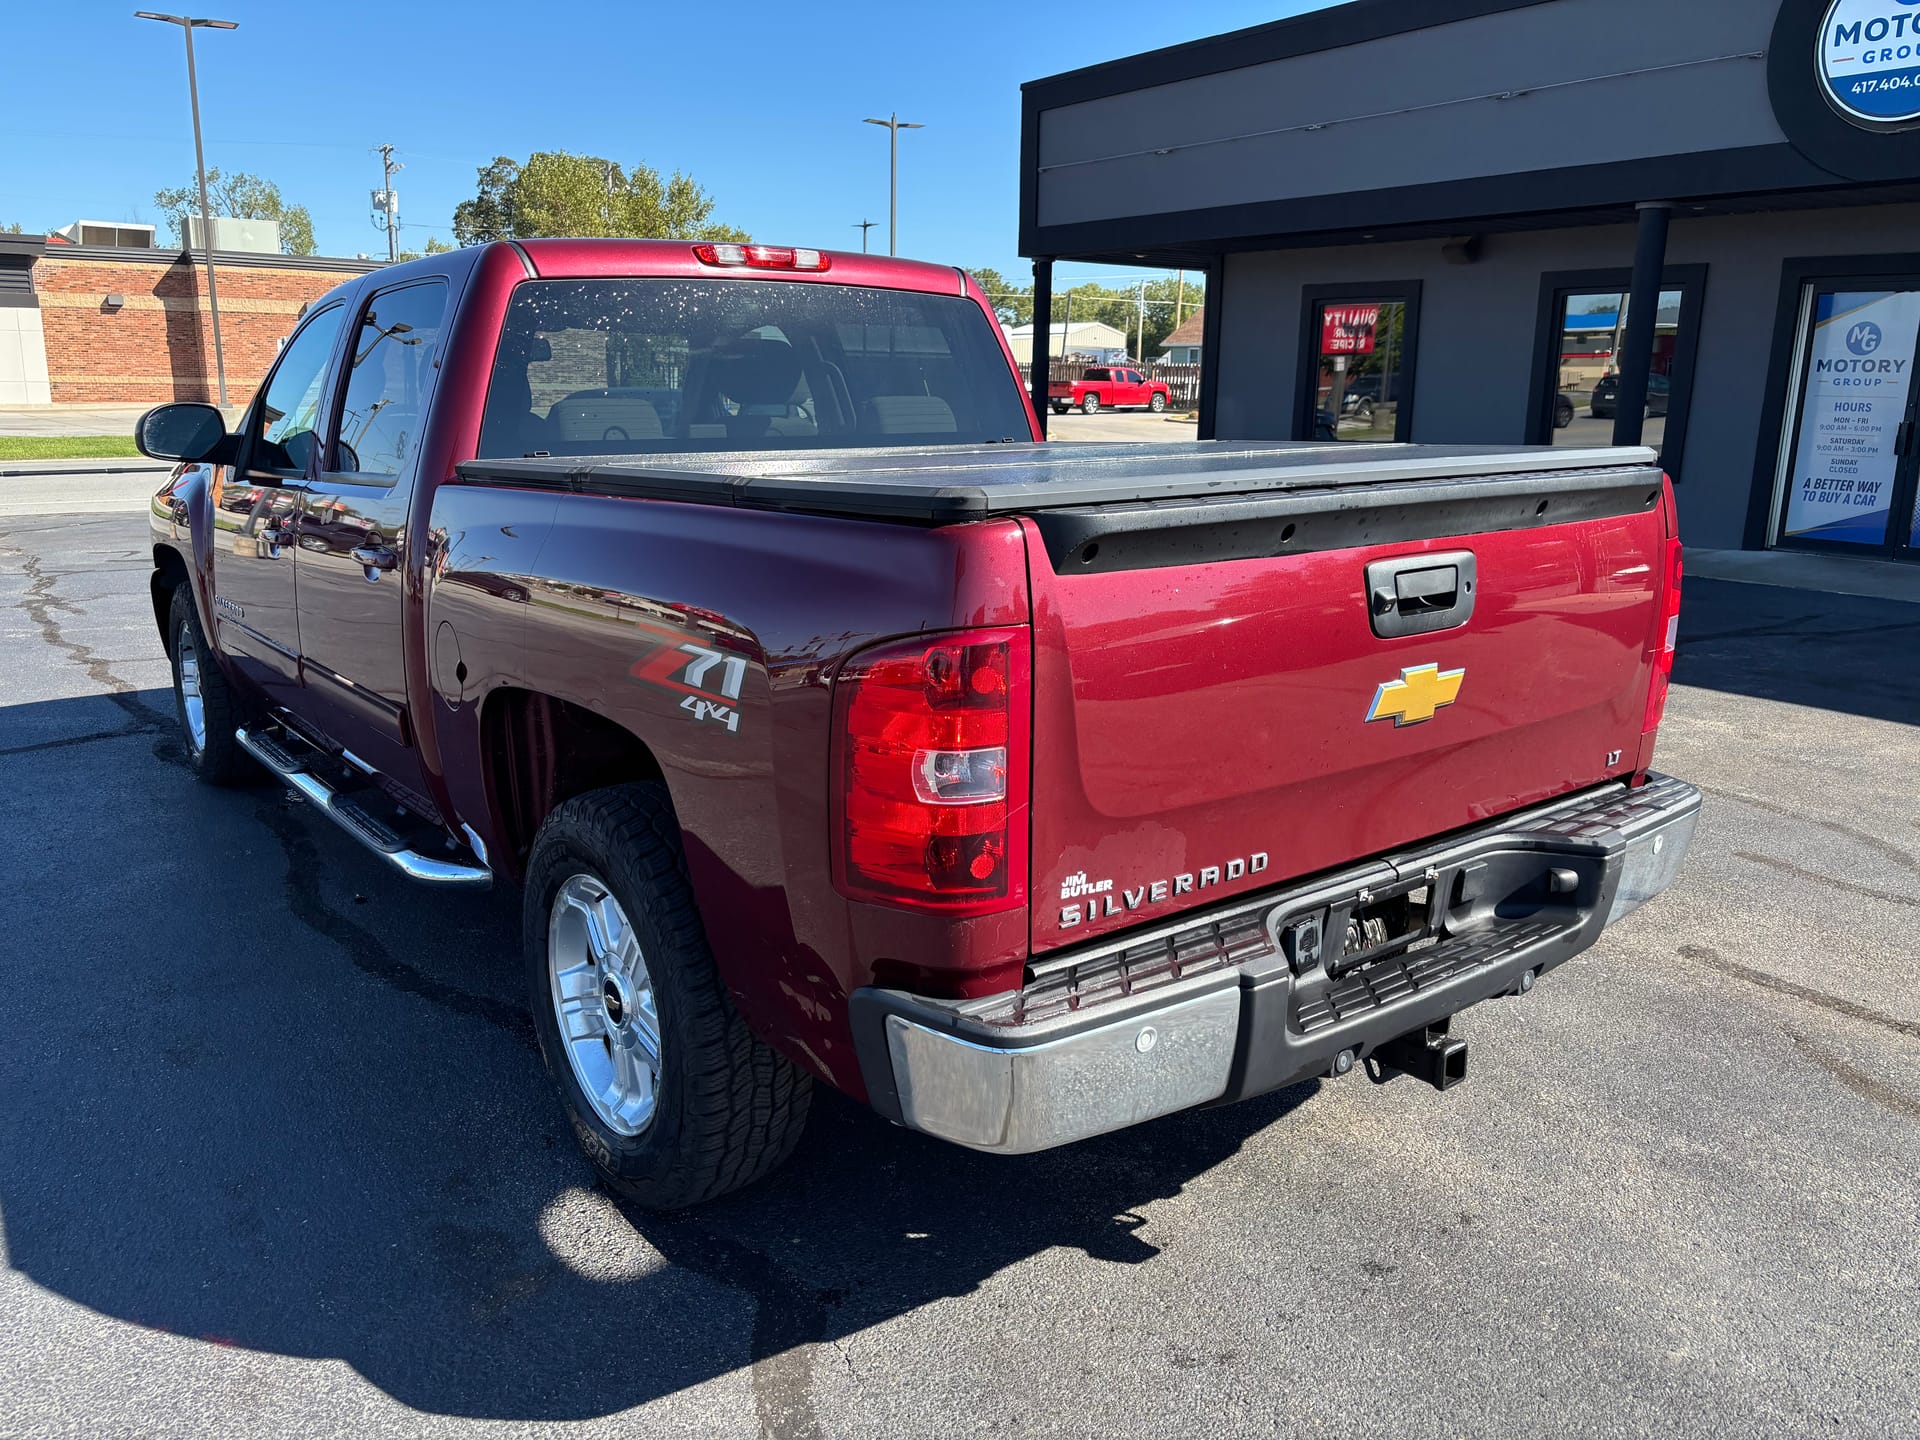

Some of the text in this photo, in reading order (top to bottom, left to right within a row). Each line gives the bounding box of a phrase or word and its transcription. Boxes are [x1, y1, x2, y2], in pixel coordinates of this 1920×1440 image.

[1850, 326, 1878, 351] MG
[1816, 358, 1906, 373] MOTORY
[1832, 377, 1882, 387] GROUP
[1834, 402, 1873, 413] HOURS
[1833, 416, 1850, 424] MON
[1870, 425, 1882, 433] PM
[1830, 437, 1865, 446] SATURDAY
[1867, 446, 1879, 454] PM
[1830, 458, 1858, 466] SUNDAY
[1829, 466, 1858, 474] CLOSED
[1802, 477, 1882, 494] A BETTER WAY
[1802, 490, 1877, 507] TO BUY A CAR
[1606, 749, 1622, 768] LT
[1061, 871, 1087, 888] JIM
[1059, 852, 1268, 929] SILVERADO
[1061, 879, 1113, 900] BUTLER
